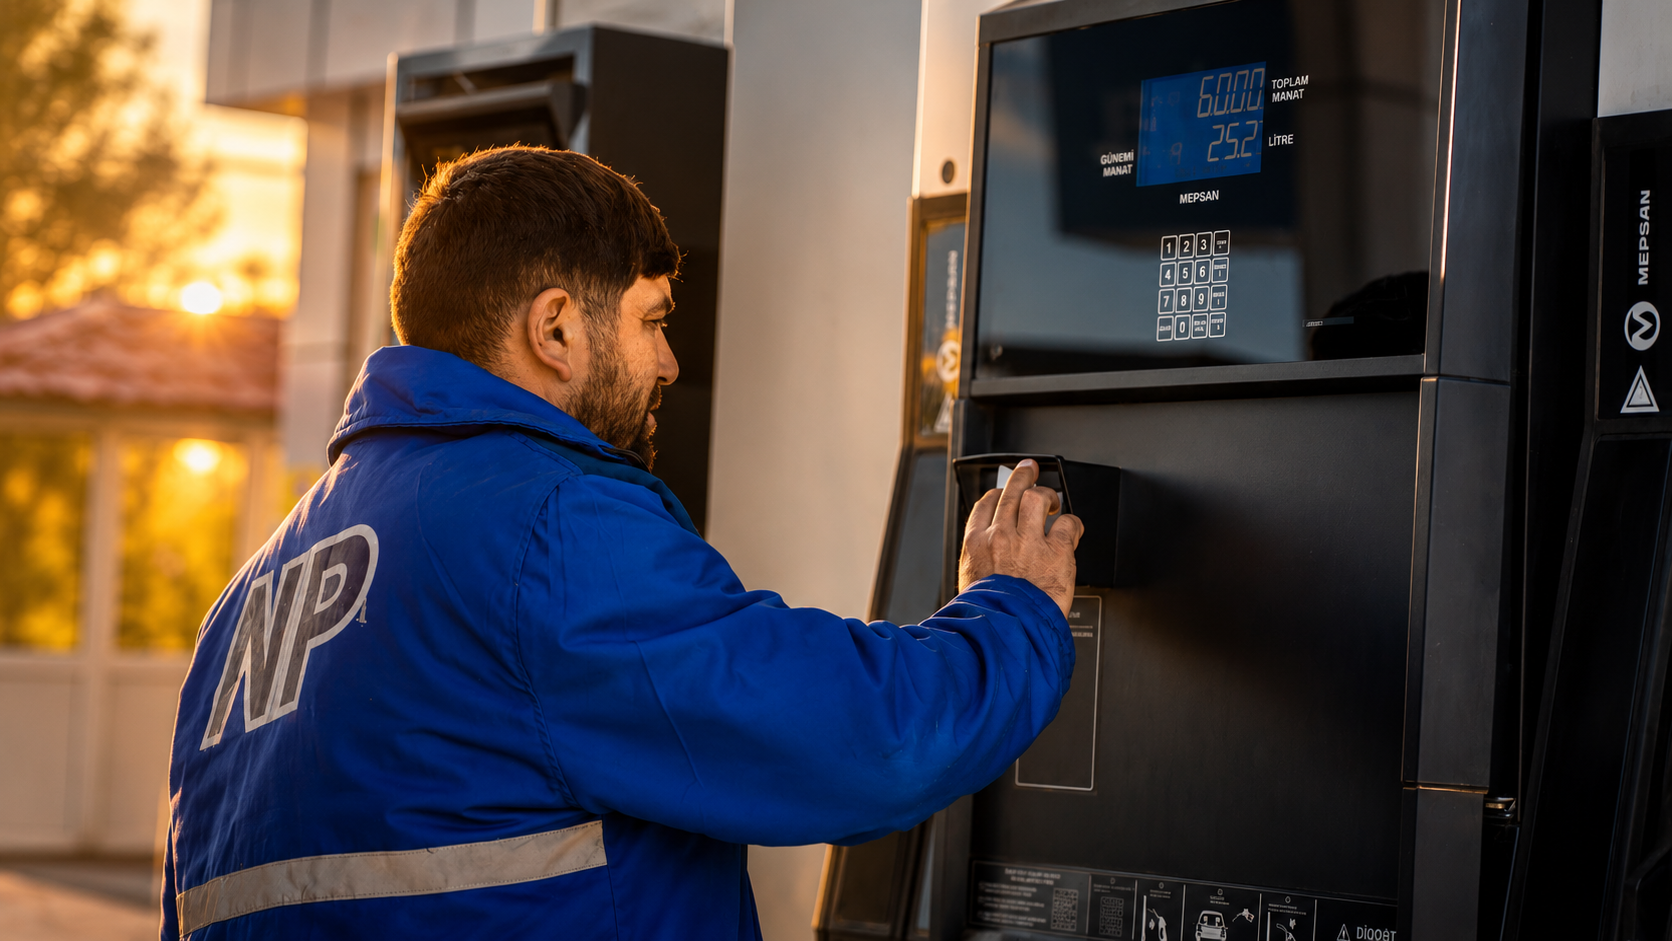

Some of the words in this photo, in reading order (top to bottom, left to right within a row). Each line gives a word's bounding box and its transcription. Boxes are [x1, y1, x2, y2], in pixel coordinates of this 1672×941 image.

[1271, 75, 1309, 90] TOPLAM
[1271, 88, 1305, 103] MANAT
[1207, 120, 1263, 162] 25.2
[1268, 133, 1294, 147] LİTRE
[1102, 164, 1133, 178] MANAT
[1179, 189, 1220, 204] MEPSAN
[1637, 190, 1651, 285] MEPSAN
[1166, 242, 1171, 254] 1
[1183, 240, 1190, 253] 2
[1200, 239, 1207, 251] 3
[1164, 269, 1171, 280] 4
[1182, 267, 1188, 279] 5
[1199, 265, 1205, 278] 6
[1163, 295, 1170, 308] 7
[1181, 294, 1187, 307] 8
[1198, 293, 1204, 305] 9
[1179, 321, 1186, 333] 0
[200, 524, 379, 751] NP
